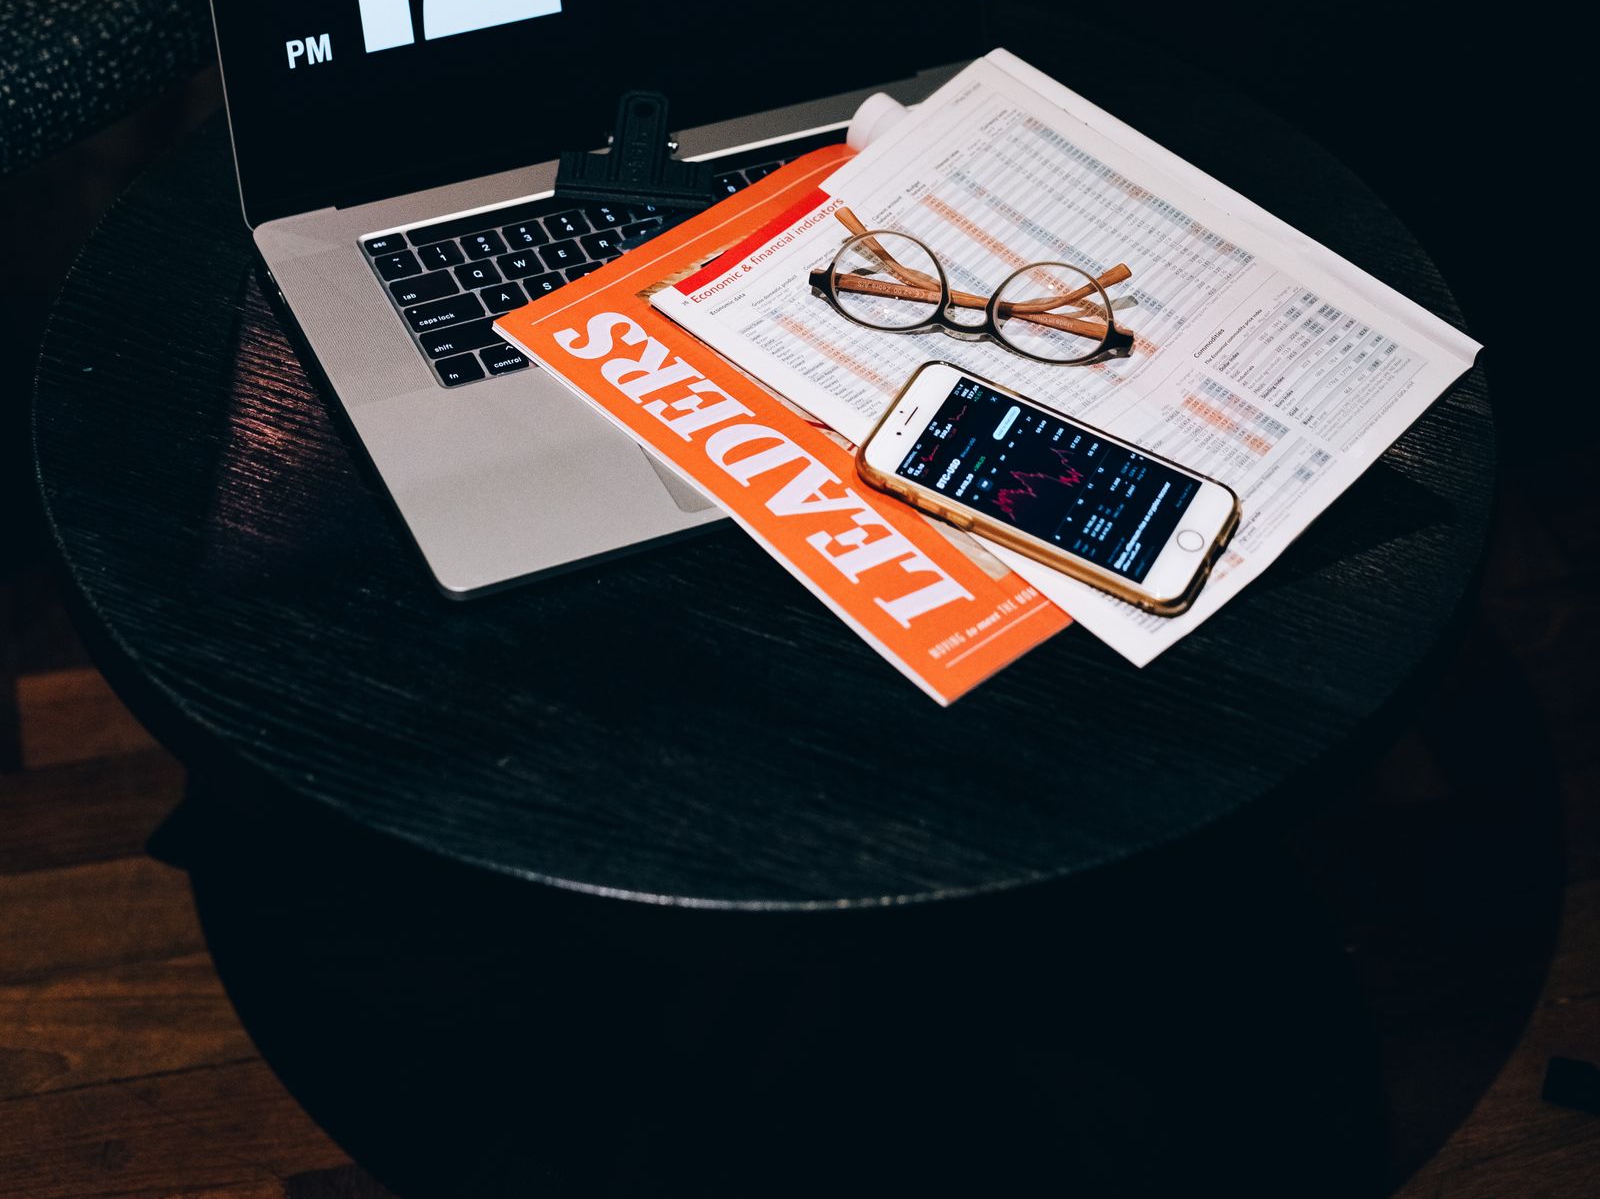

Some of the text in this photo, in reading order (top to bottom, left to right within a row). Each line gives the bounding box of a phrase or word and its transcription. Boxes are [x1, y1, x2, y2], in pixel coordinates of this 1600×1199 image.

[285, 33, 333, 69] PM
[606, 214, 615, 222] 5
[566, 224, 574, 232] 4
[524, 234, 532, 242] 3
[482, 244, 490, 252] 2
[599, 240, 609, 249] R
[558, 250, 567, 258] E
[690, 198, 844, 304] Economic & financial indicators
[440, 254, 446, 262] 1
[513, 259, 526, 268] W
[473, 270, 483, 278] Q
[542, 282, 552, 290] S
[501, 293, 510, 301] A
[710, 292, 746, 316] Economic data
[419, 313, 455, 326] caps lock
[1193, 327, 1225, 359] Commodities
[434, 344, 454, 353] shift
[494, 357, 522, 368] control
[552, 311, 976, 629] LEADERS
[935, 456, 962, 490] BTC-USD
